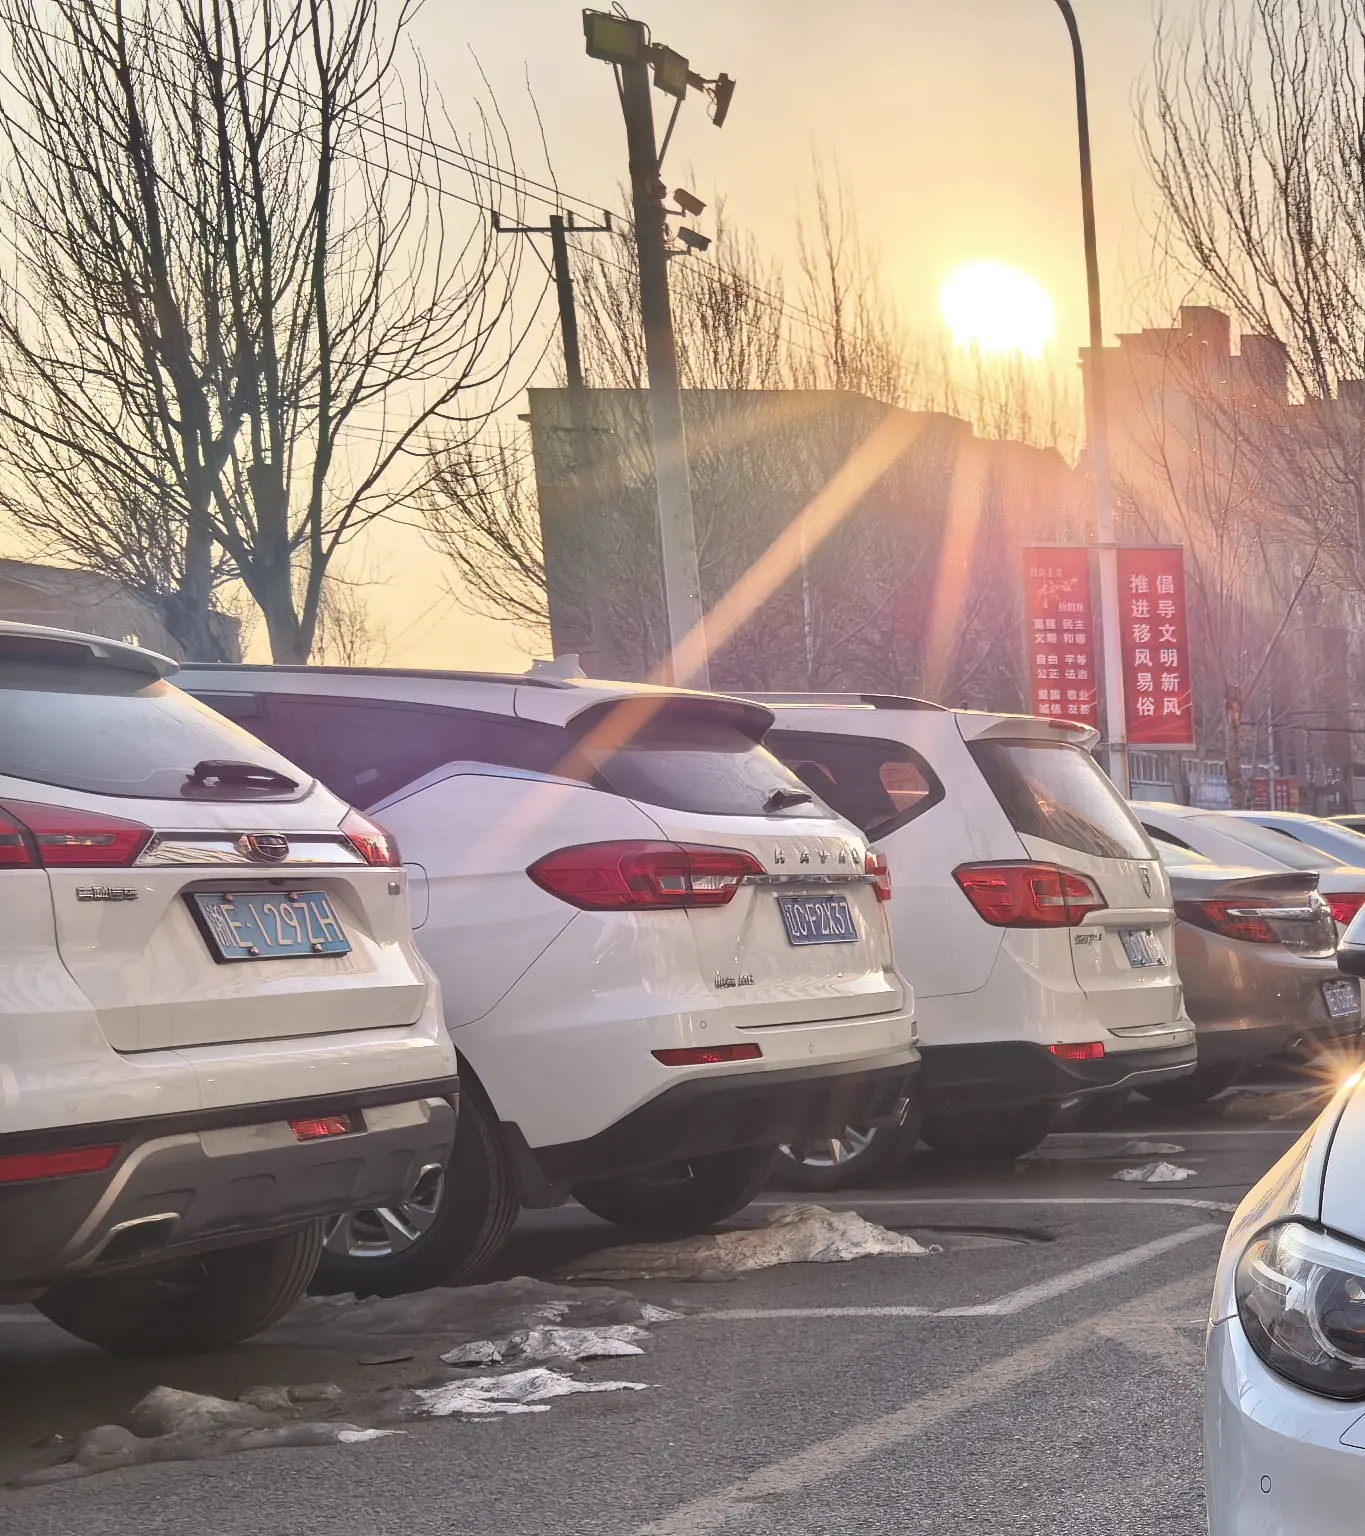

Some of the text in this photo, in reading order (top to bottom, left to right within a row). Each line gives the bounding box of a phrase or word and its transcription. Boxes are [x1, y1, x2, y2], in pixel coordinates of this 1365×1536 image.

[1130, 574, 1156, 716] 推进移风易俗
